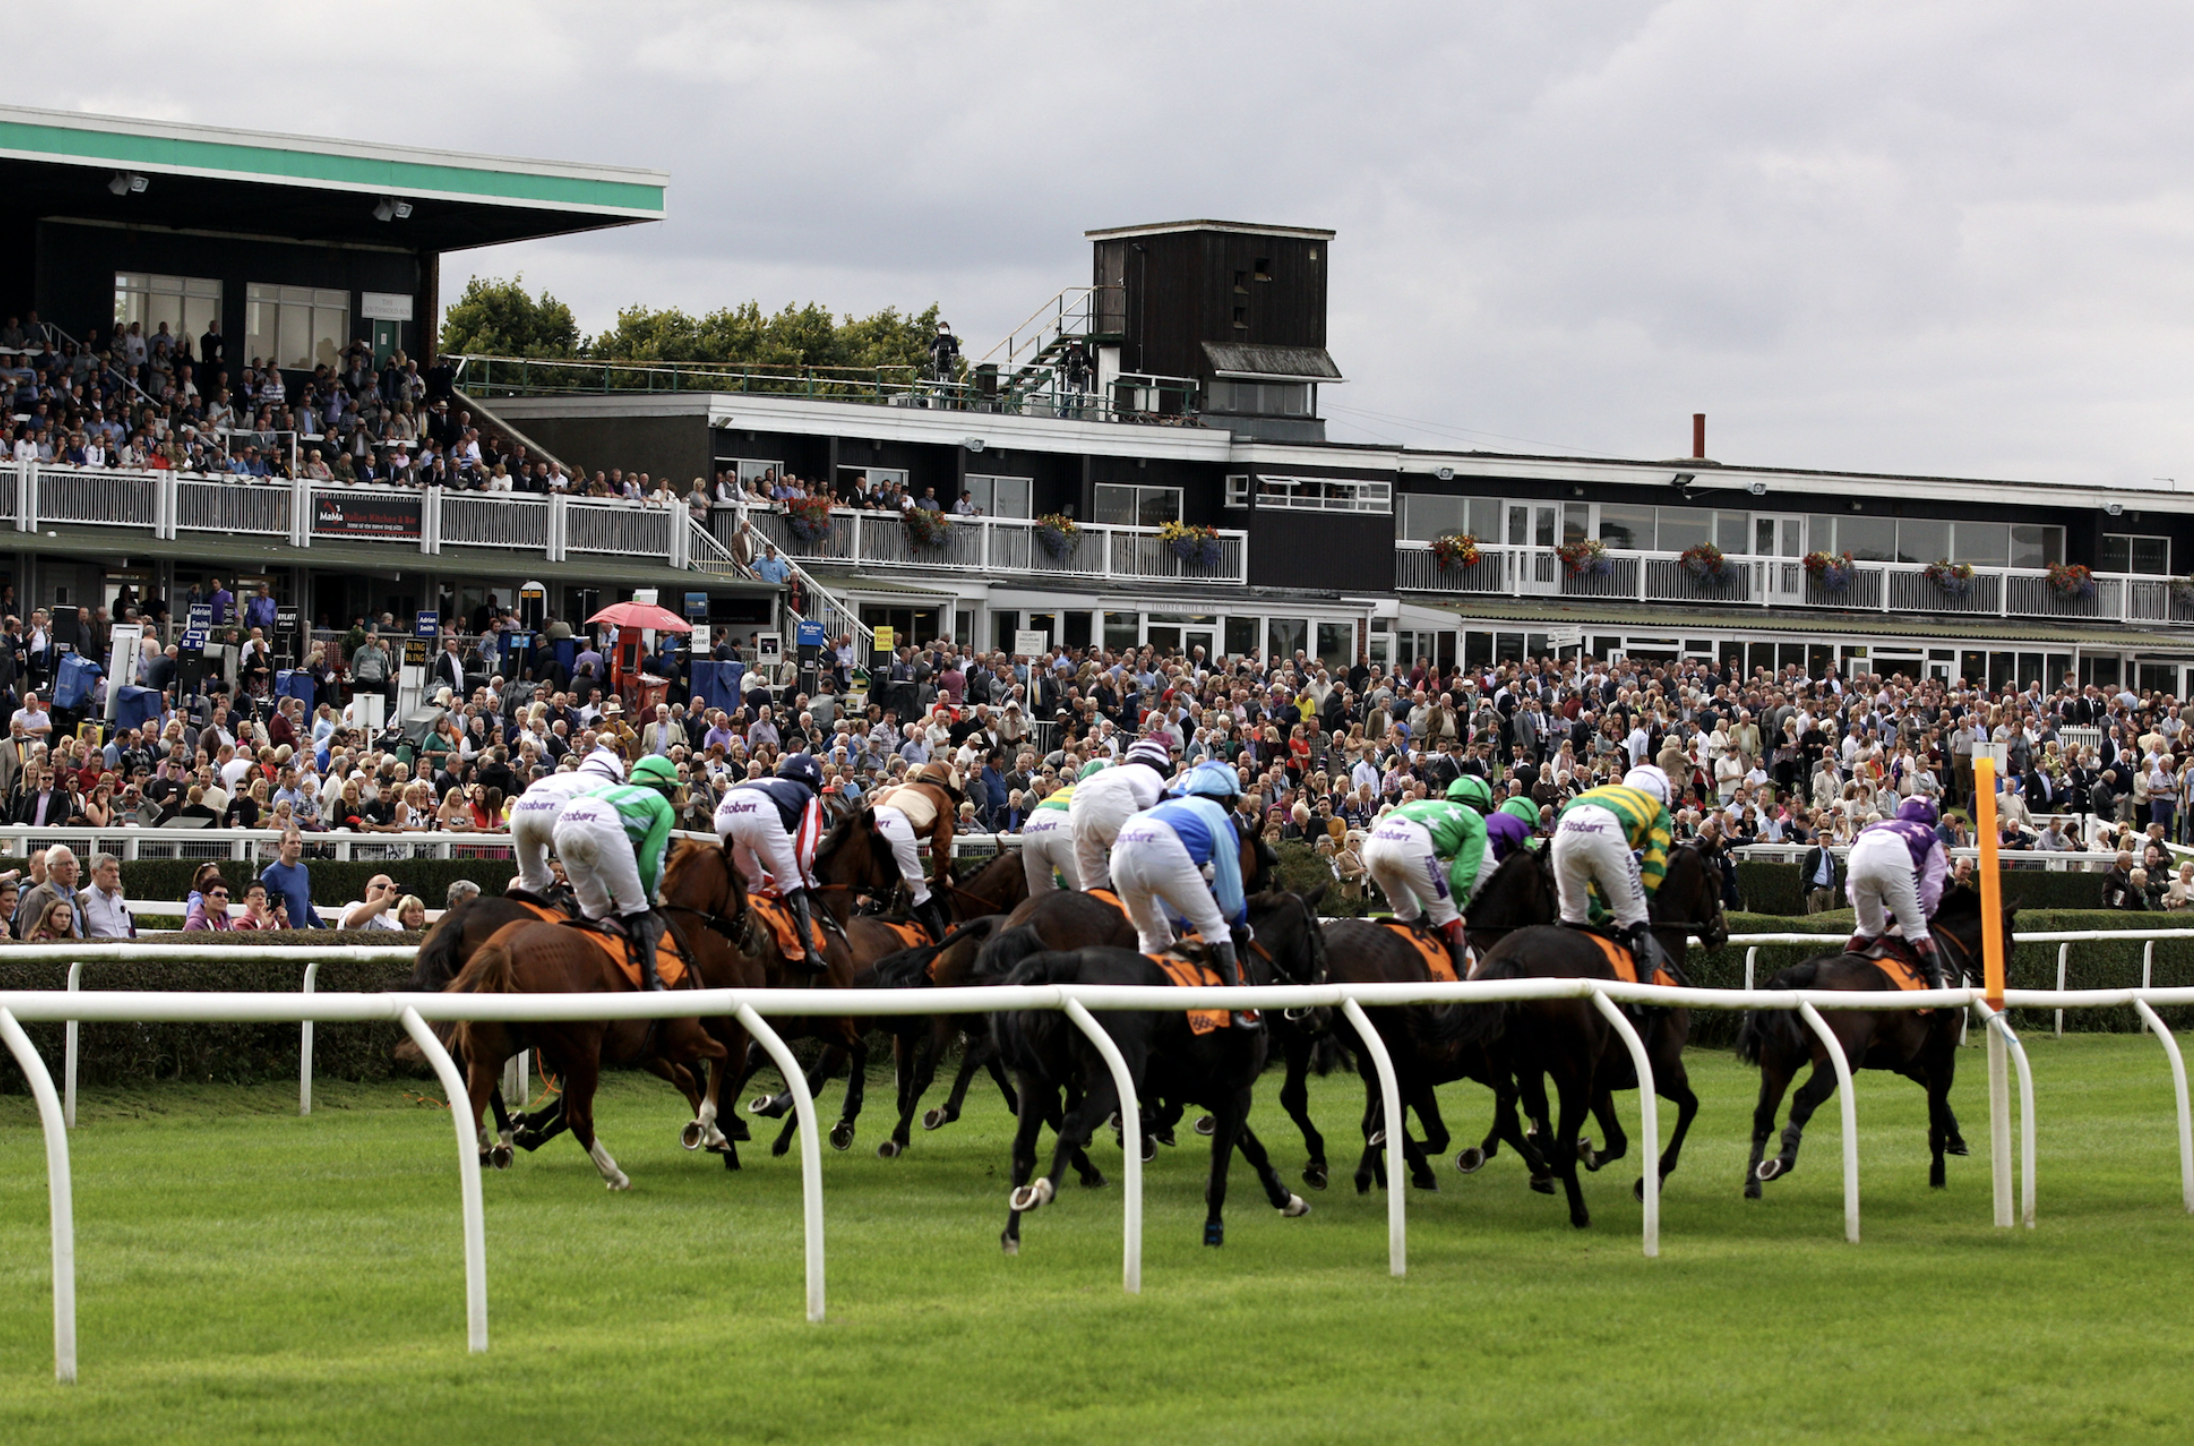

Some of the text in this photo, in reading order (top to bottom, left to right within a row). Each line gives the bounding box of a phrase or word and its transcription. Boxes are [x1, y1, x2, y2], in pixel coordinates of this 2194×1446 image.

[192, 620, 210, 629] Smith
[406, 642, 425, 651] BLING
[405, 653, 425, 662] BLING
[517, 800, 555, 811] Stobart
[720, 801, 757, 815] Stobart
[560, 810, 598, 822] Stobart
[1562, 821, 1604, 833] Stobart
[1373, 829, 1411, 841] Stobart
